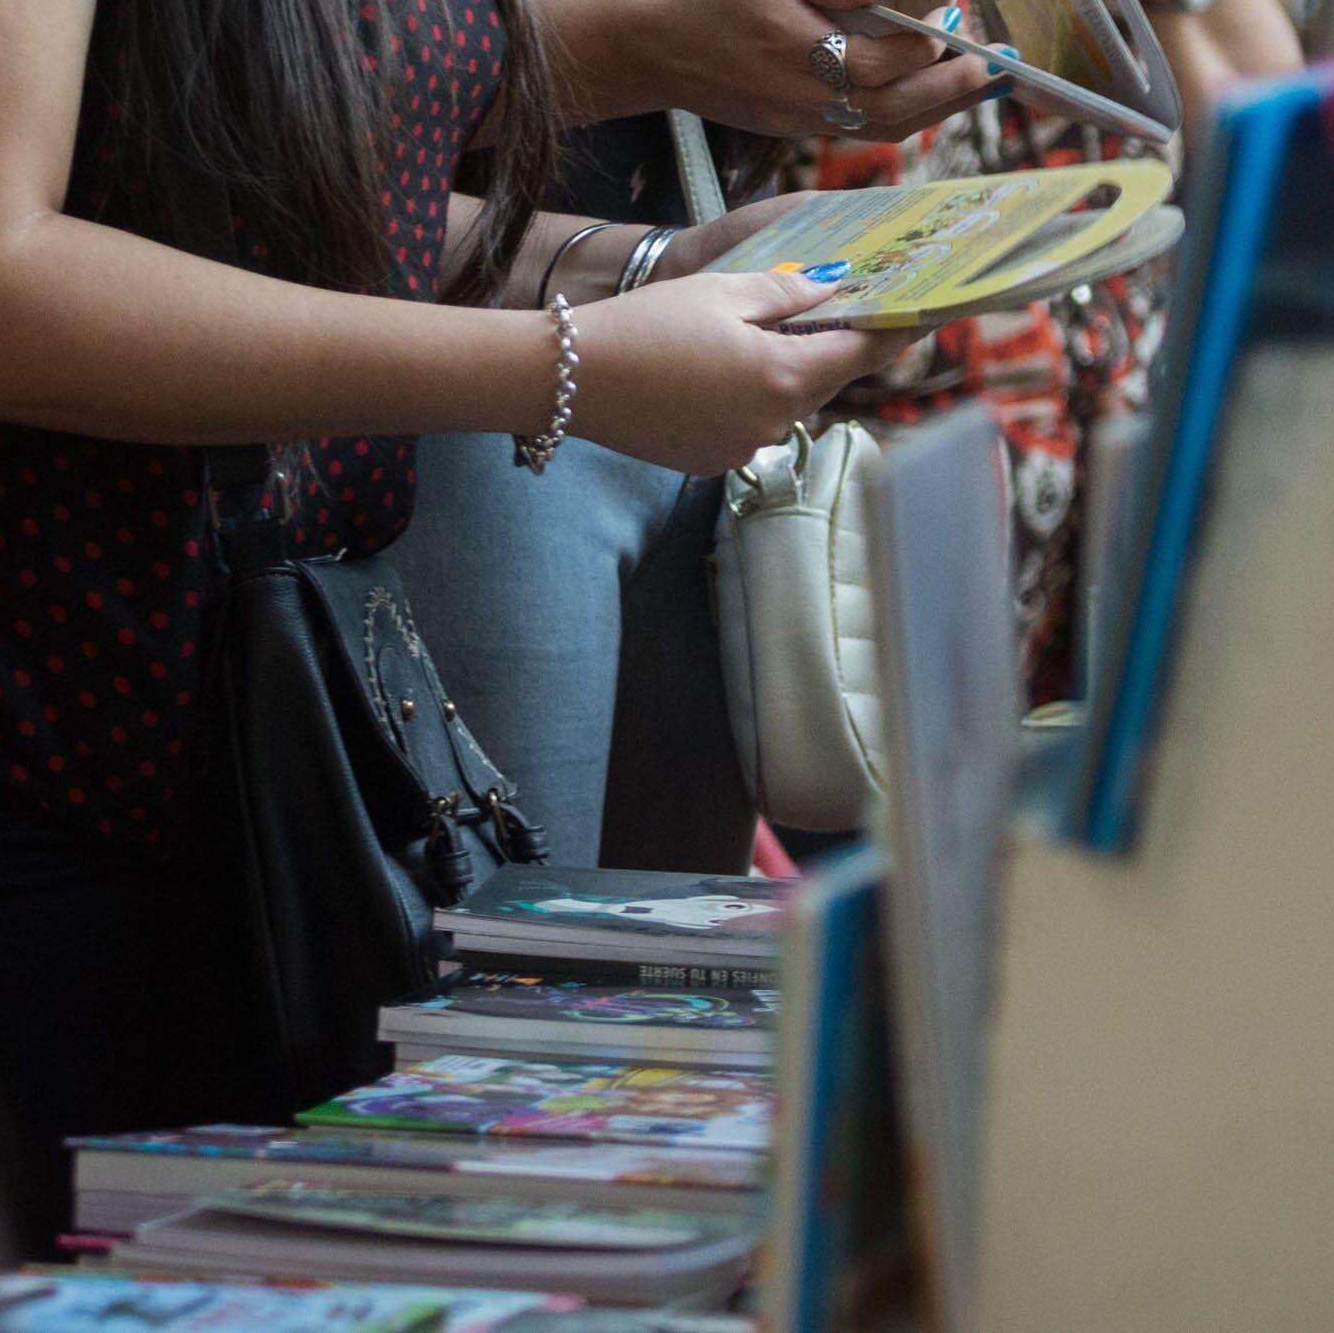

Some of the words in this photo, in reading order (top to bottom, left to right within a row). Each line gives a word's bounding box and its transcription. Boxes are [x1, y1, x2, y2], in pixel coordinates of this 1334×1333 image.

[639, 965, 686, 979] SUERTE
[690, 968, 706, 978] TU
[711, 969, 728, 982] EN
